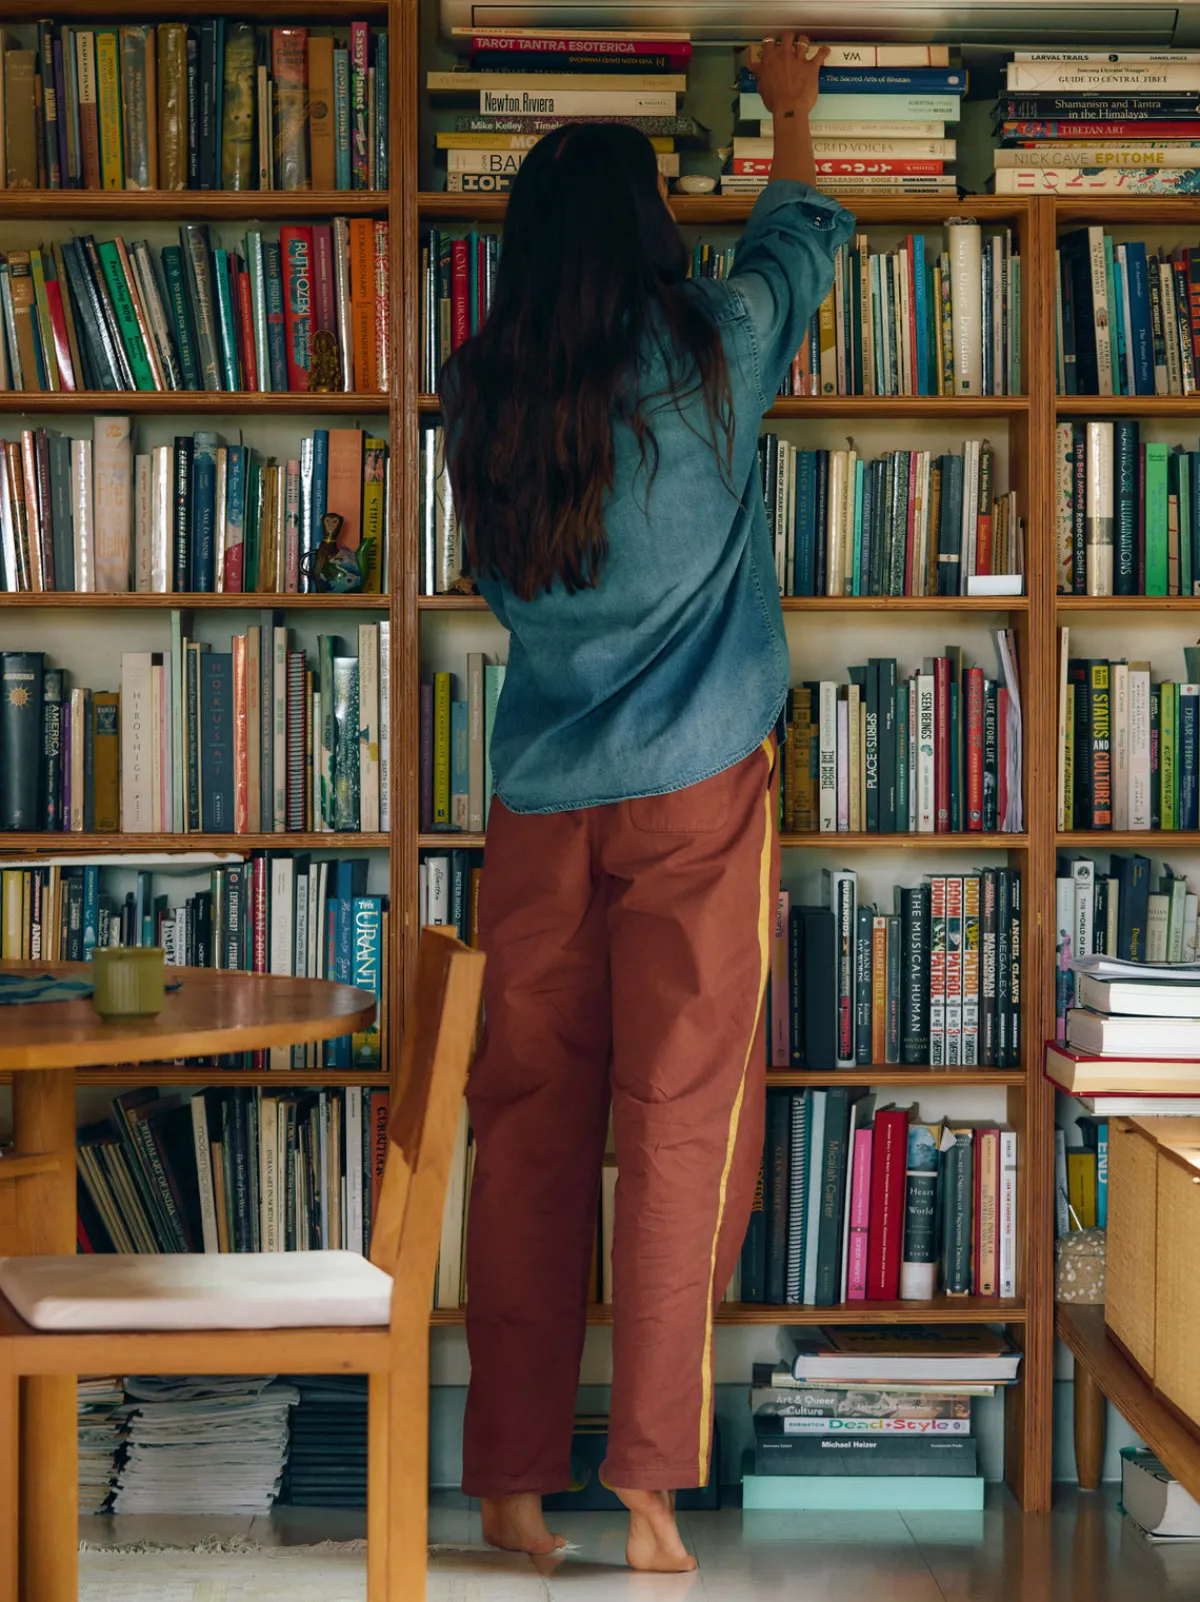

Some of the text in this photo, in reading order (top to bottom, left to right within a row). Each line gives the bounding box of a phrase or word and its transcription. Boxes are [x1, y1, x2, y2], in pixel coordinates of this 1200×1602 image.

[354, 29, 366, 110] Sassy Planet
[476, 38, 635, 53] TAROT TANTRA ESOTERICA
[472, 121, 492, 129] Mike
[496, 121, 522, 132] Kelley
[523, 92, 554, 112] Riviera
[1056, 100, 1160, 108] Shamanism and Tantra
[1080, 110, 1097, 118] the
[1100, 110, 1148, 119] Himalayas
[1061, 126, 1124, 134] TIBETAN ART
[1015, 153, 1164, 164] NICK CAVE EPITOME
[109, 260, 127, 302] Everything
[268, 248, 279, 314] Annie PROULX
[294, 242, 311, 316] RUTH OZEKI
[173, 283, 190, 366] TO SPEAK FOR THE TREES
[956, 239, 971, 375] Mary Oliver Devotions
[1153, 305, 1161, 335] VONNEGUT
[1139, 341, 1147, 360] Future
[1140, 362, 1148, 380] Poetry
[1076, 444, 1084, 458] The
[1121, 428, 1132, 575] ALAN MOORE ILLUMINATIONS
[1076, 513, 1084, 547] Rebecca
[51, 704, 59, 757] AMERICA
[132, 692, 141, 783] HIROSHIGE
[212, 663, 221, 776] HOKUSAI
[866, 713, 877, 747] SPIRITS
[921, 692, 932, 740] SEEN BEINGS
[986, 698, 994, 763] LIFE BEFORE LIFE
[1184, 708, 1194, 769] DEAR THEO
[867, 753, 877, 788] PLACE
[1093, 694, 1109, 805] STATUS AND CULTURE
[1163, 746, 1172, 810] KURT VONNEGUT
[355, 910, 378, 996] URANT
[875, 931, 883, 974] ECKHART
[912, 894, 921, 1032] THE MUSICAL HUMAN
[931, 880, 944, 998] DOOM PATROL
[947, 880, 961, 998] DOOM PATROL
[965, 879, 978, 997] DOOM PATROL
[1011, 918, 1019, 1004] ANGEL CLAWS
[1080, 936, 1085, 945] OF
[999, 933, 1007, 998] MEGALEX
[141, 1126, 156, 1157] RITUAL
[150, 1159, 162, 1174] ART
[162, 1189, 176, 1215] INDIA
[824, 1140, 839, 1218] Micaiah Carter
[776, 1395, 835, 1405] Art & Queer
[787, 1406, 823, 1416] Culture
[829, 1419, 949, 1431] Dead Style
